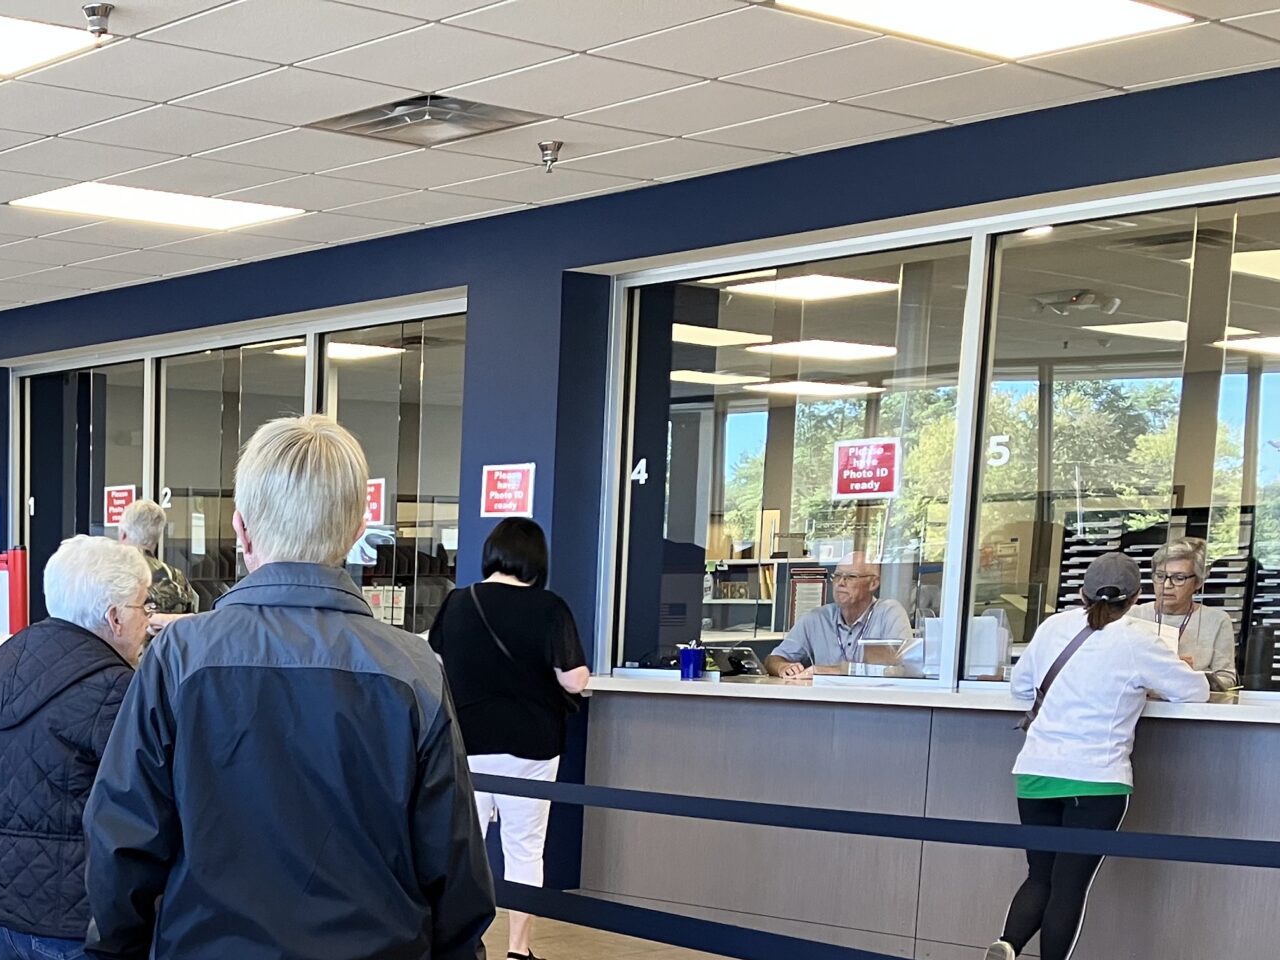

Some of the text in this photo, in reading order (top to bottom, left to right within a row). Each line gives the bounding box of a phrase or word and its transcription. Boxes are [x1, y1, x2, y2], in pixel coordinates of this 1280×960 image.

[987, 435, 1010, 467] 5
[630, 458, 648, 485] 4
[843, 467, 888, 479] Photo ID
[850, 480, 880, 491] ready
[161, 487, 172, 509] 2
[489, 490, 524, 500] Photo ID
[28, 496, 35, 516] 1
[494, 501, 517, 511] ready
